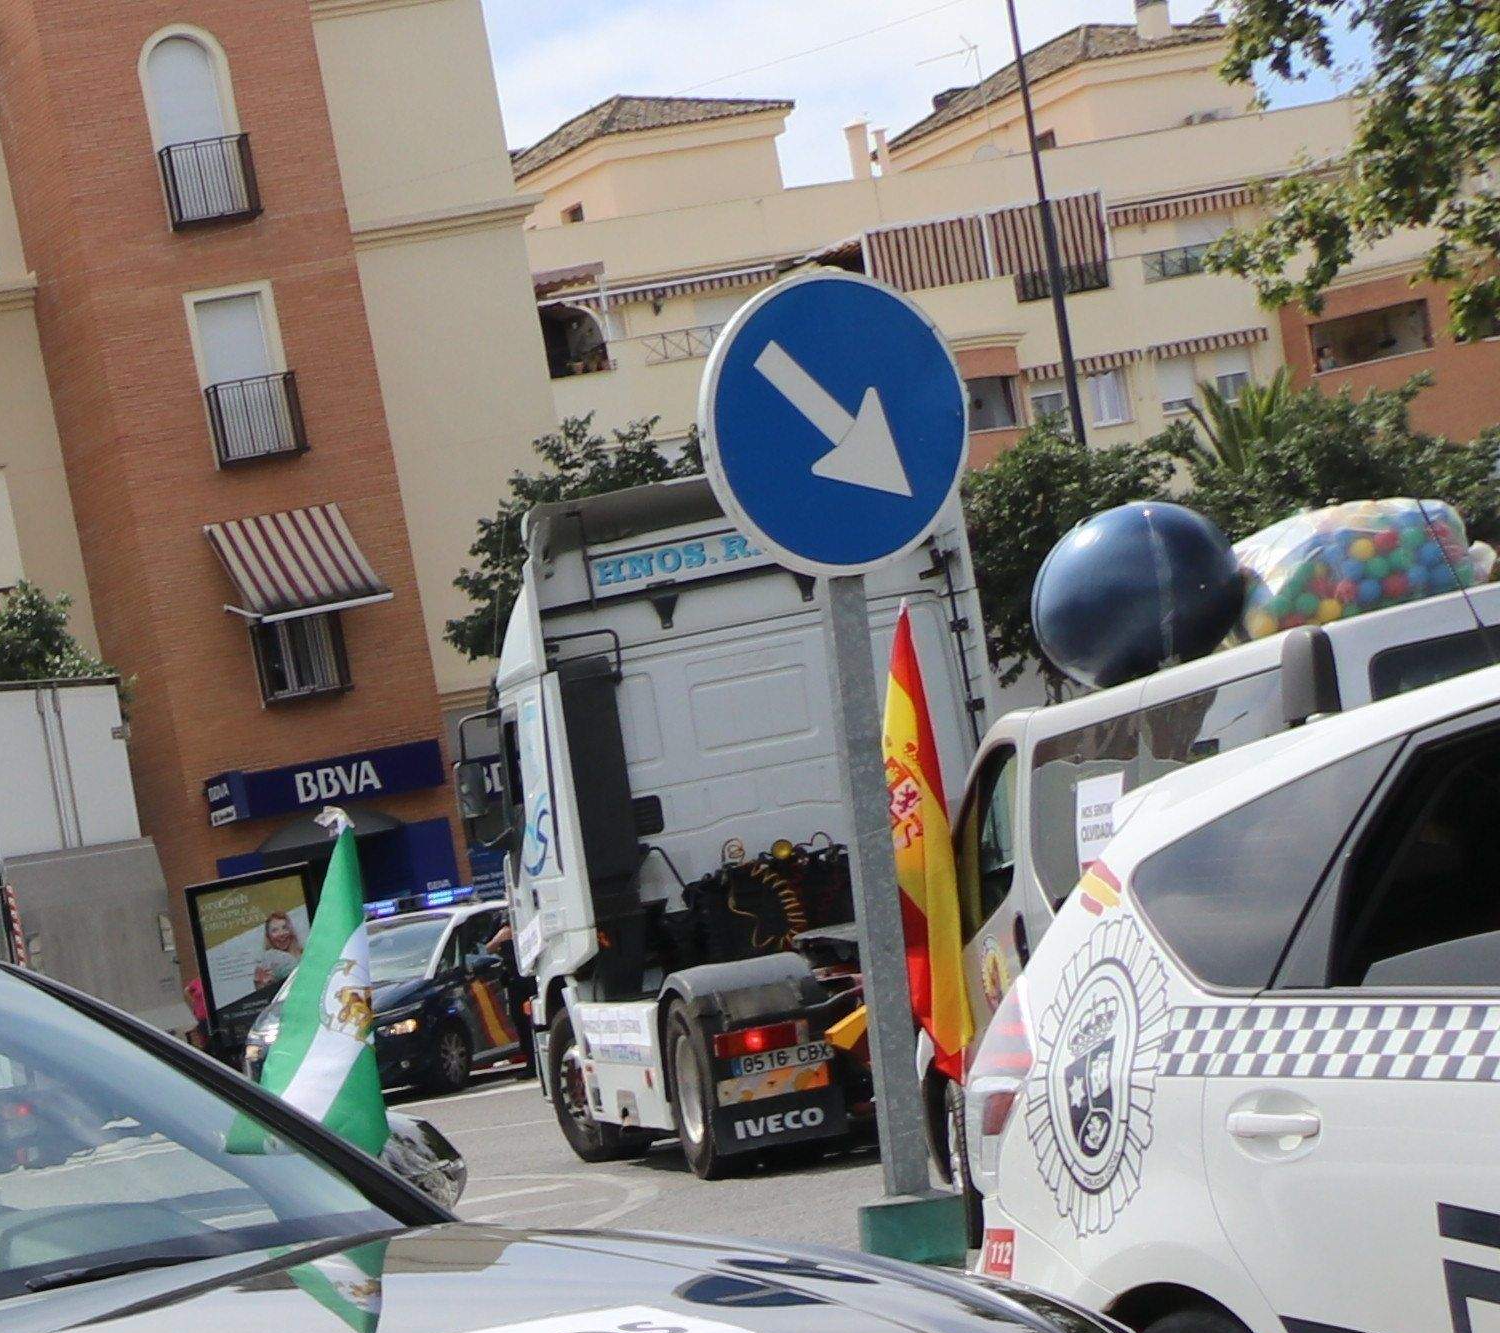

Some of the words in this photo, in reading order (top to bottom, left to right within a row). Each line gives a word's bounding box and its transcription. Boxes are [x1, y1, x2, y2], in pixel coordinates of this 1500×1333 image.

[294, 760, 382, 804] BBVA
[734, 1107, 825, 1140] IVECO
[991, 1241, 1012, 1265] 112
